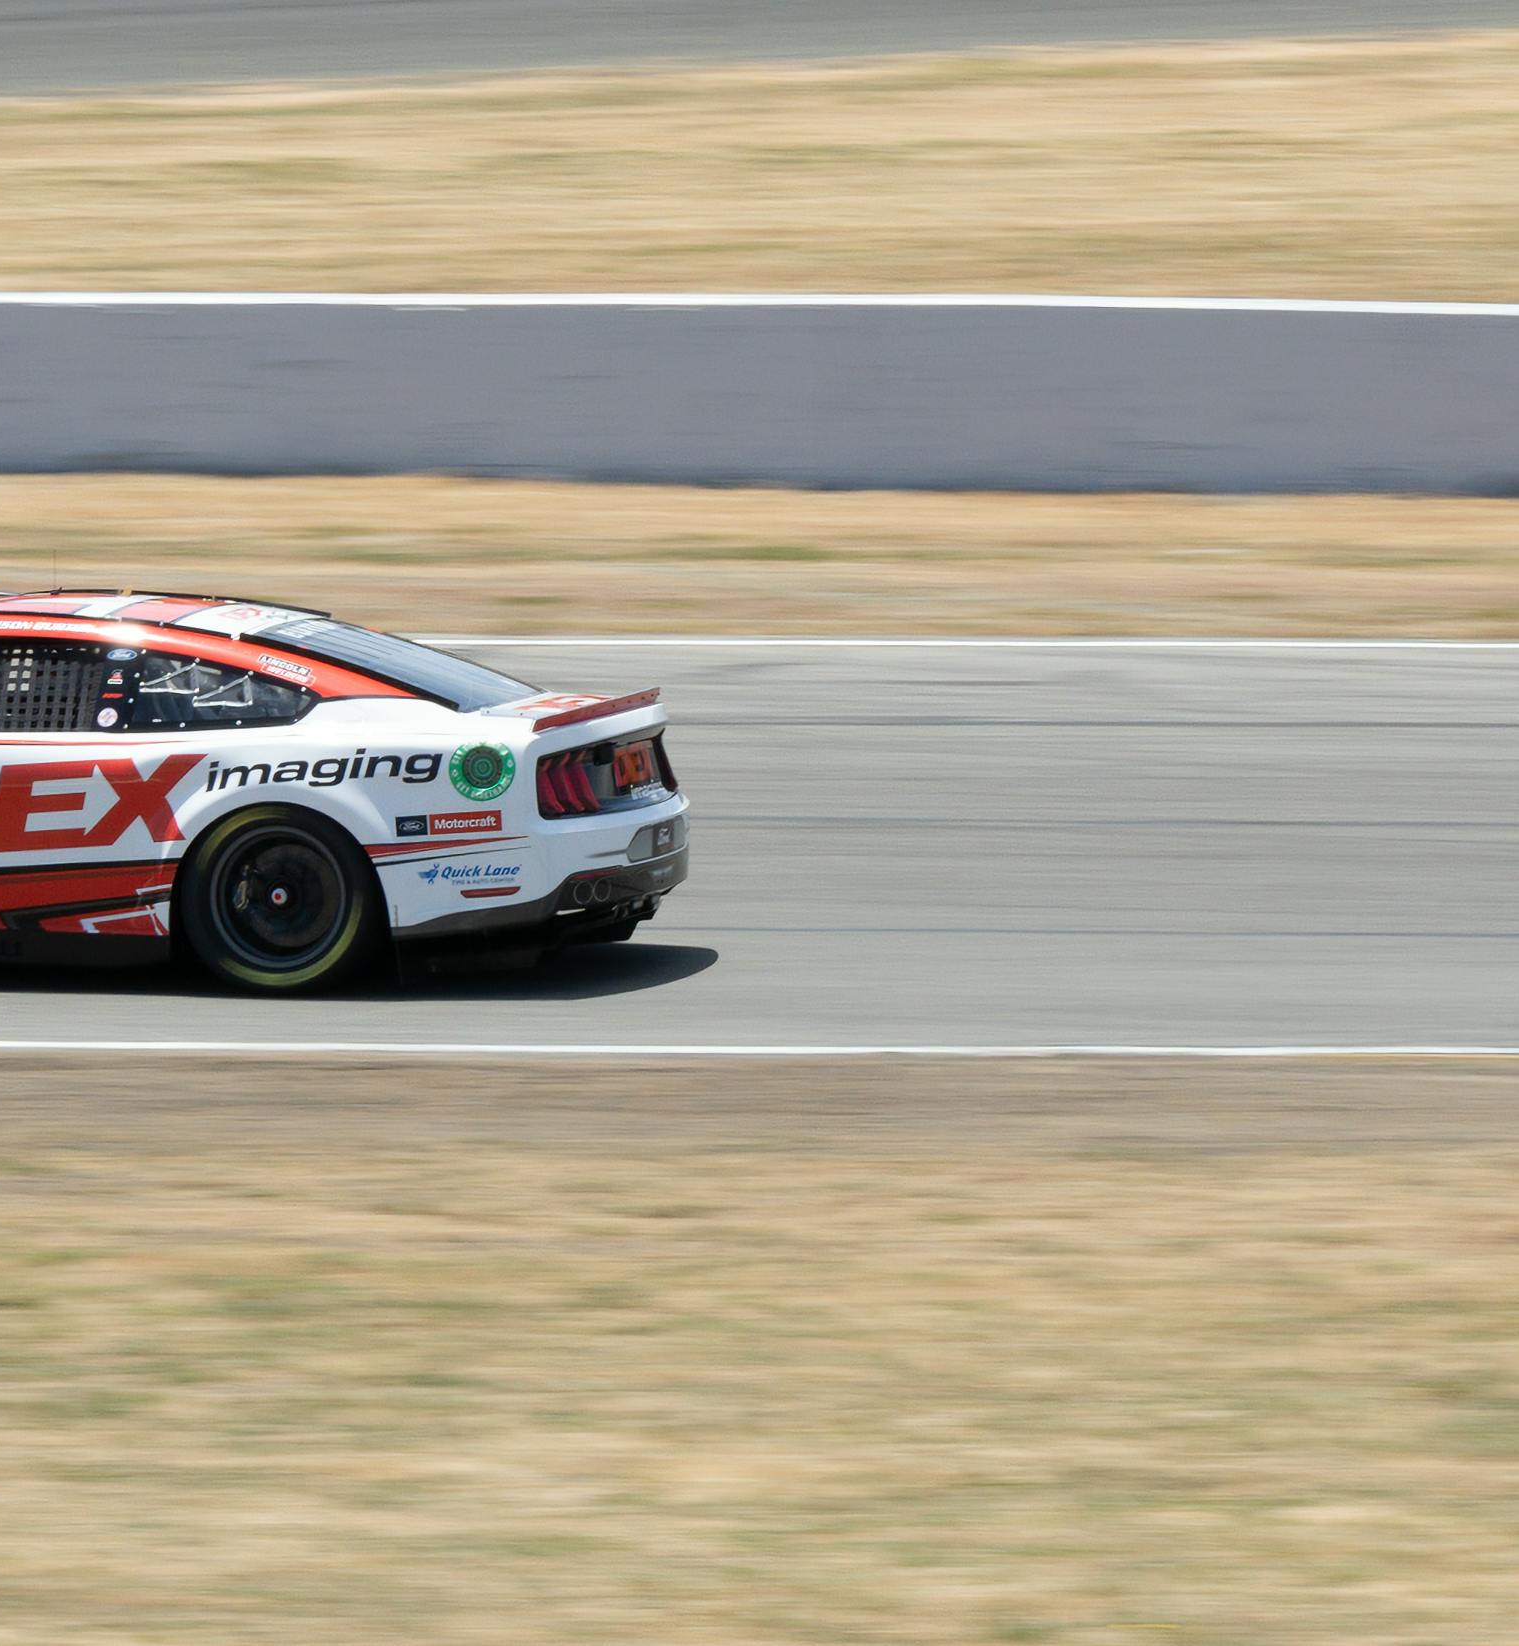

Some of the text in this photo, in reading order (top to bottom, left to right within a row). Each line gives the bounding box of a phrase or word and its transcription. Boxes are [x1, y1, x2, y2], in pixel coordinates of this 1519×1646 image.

[205, 748, 443, 792] imaging
[434, 816, 497, 829] Motorcraft
[441, 864, 521, 879] Quick Lane
